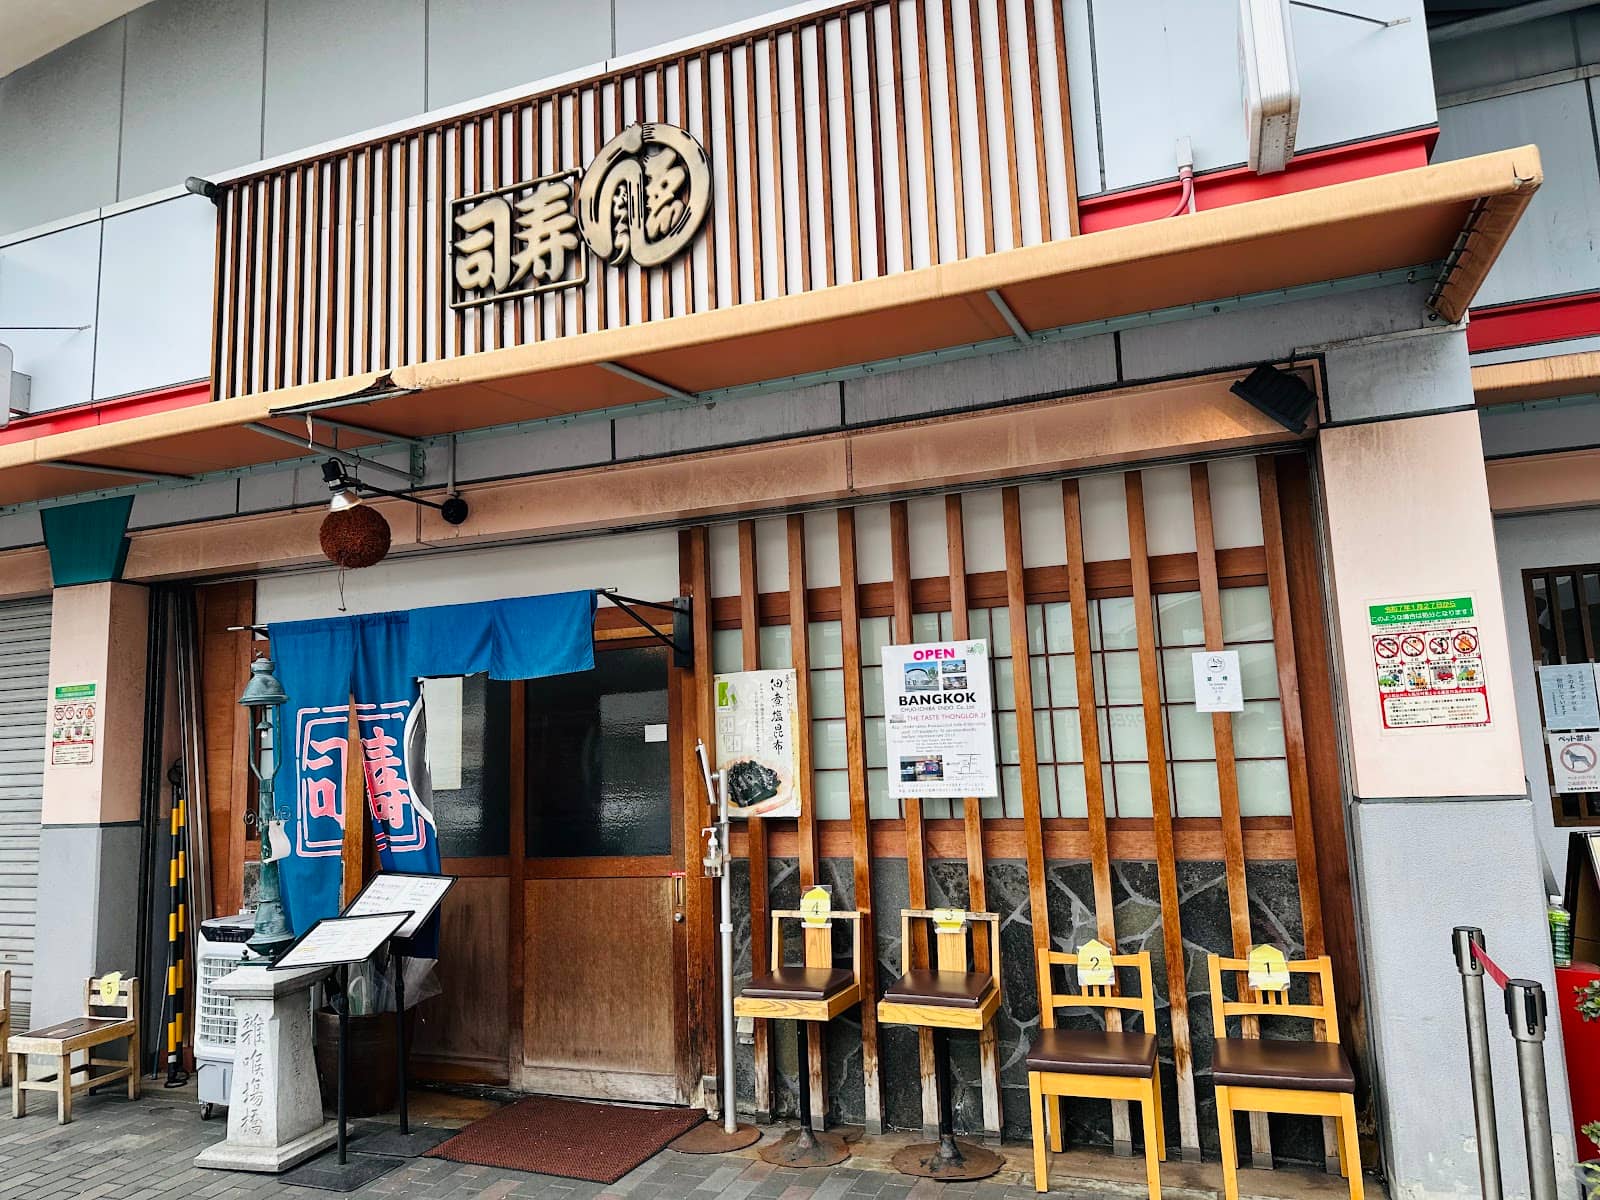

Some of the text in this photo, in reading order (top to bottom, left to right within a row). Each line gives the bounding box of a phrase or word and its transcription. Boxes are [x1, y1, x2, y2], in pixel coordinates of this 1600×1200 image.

[913, 648, 955, 660] OPEN
[898, 692, 976, 706] BANGKOK
[907, 714, 919, 722] THE
[811, 901, 819, 916] 4
[1089, 956, 1101, 971] 2
[1263, 961, 1271, 976] 1
[106, 982, 113, 995] 5
